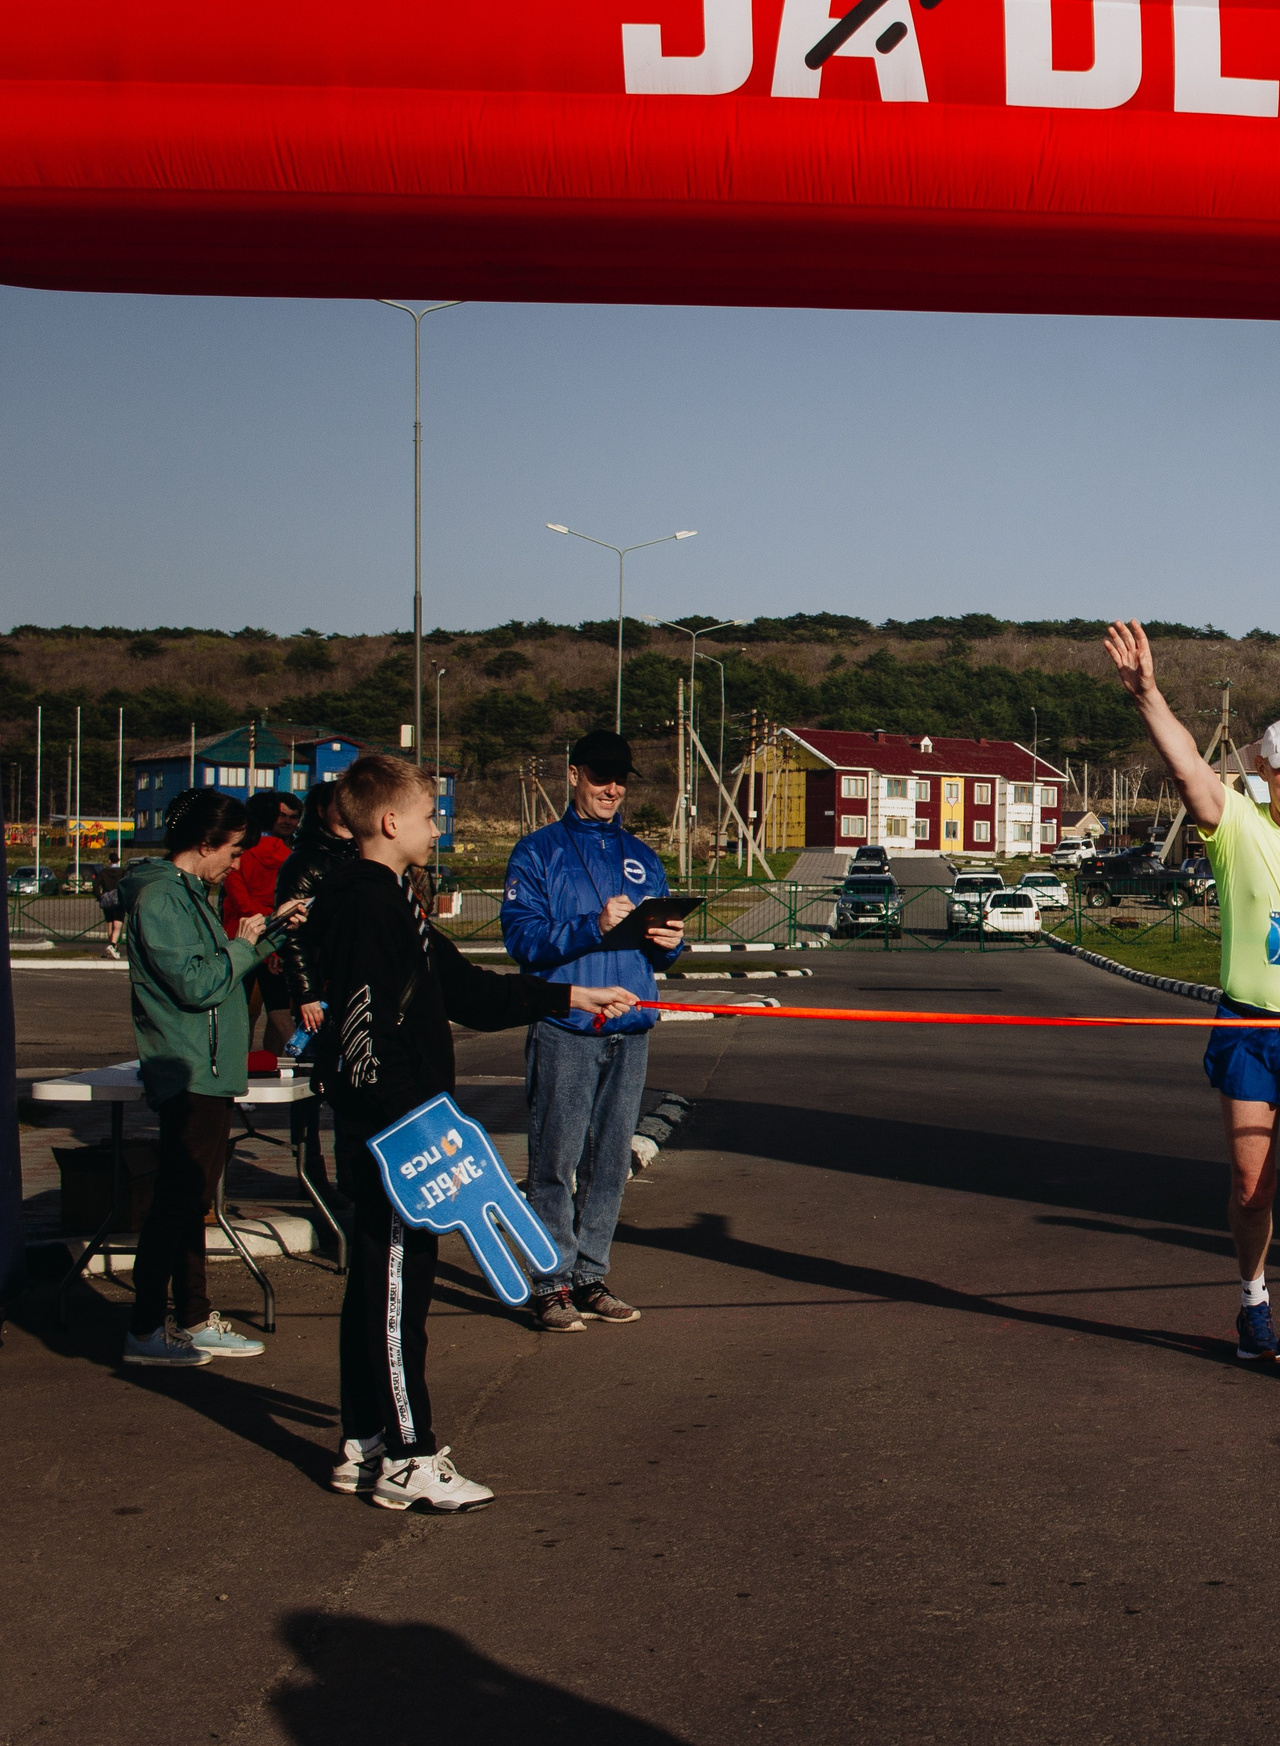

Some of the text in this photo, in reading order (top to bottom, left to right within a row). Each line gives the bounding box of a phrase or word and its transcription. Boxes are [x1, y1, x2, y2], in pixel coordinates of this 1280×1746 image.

[400, 1145, 442, 1180] ПСБ
[389, 1281, 397, 1314] YOURSELF
[388, 1315, 396, 1333] OPEN
[391, 1371, 403, 1404] YOURSELF
[398, 1404, 408, 1423] OPEN
